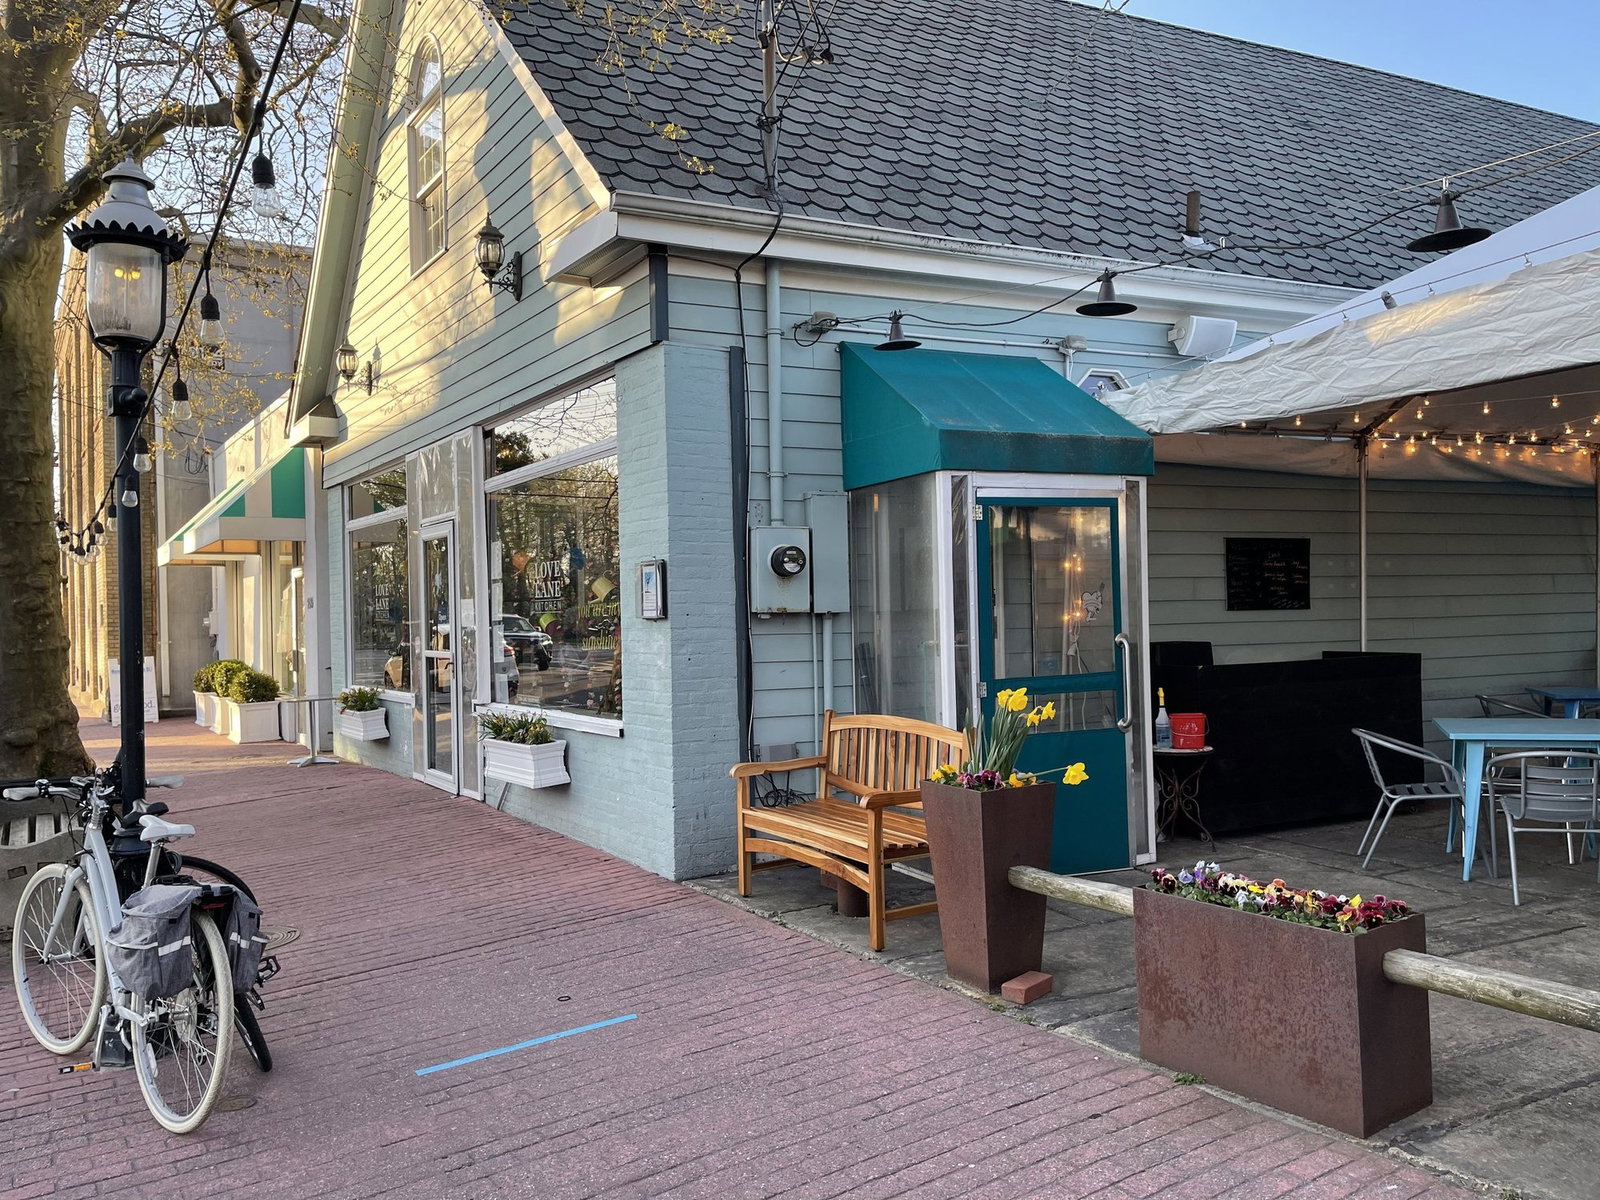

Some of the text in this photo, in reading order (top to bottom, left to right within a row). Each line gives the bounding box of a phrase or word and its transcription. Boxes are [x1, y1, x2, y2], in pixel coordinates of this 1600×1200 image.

[534, 560, 560, 579] LOVE
[375, 583, 389, 597] LOVE
[535, 580, 561, 598] LANE
[375, 597, 389, 610] LANE
[534, 601, 562, 611] KITCHEN
